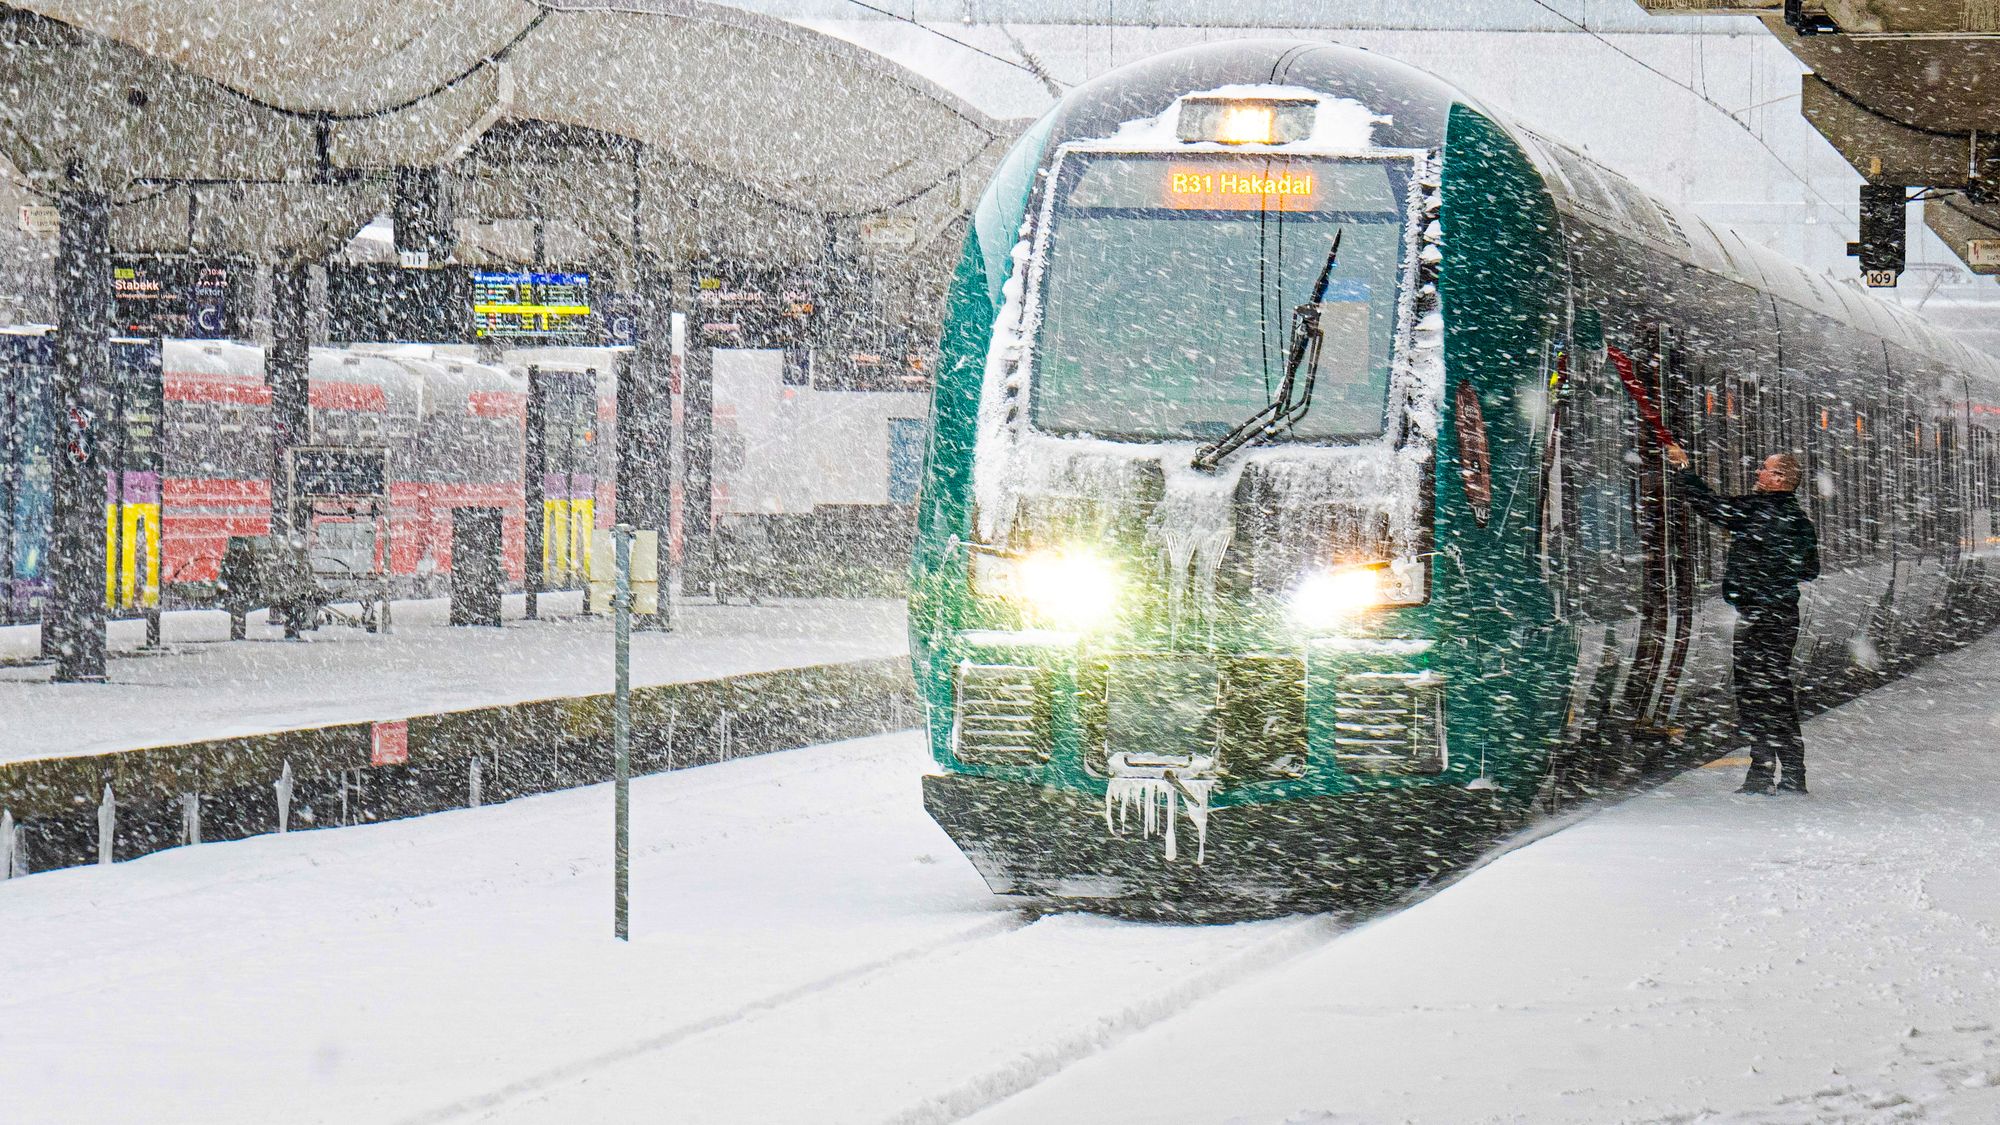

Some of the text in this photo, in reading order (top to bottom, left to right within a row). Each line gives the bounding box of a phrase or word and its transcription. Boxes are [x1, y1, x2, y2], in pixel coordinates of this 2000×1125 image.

[1172, 173, 1312, 194] R31 Hakadal
[115, 279, 160, 291] Stabekk
[1870, 273, 1891, 284] 109
[199, 308, 217, 331] C
